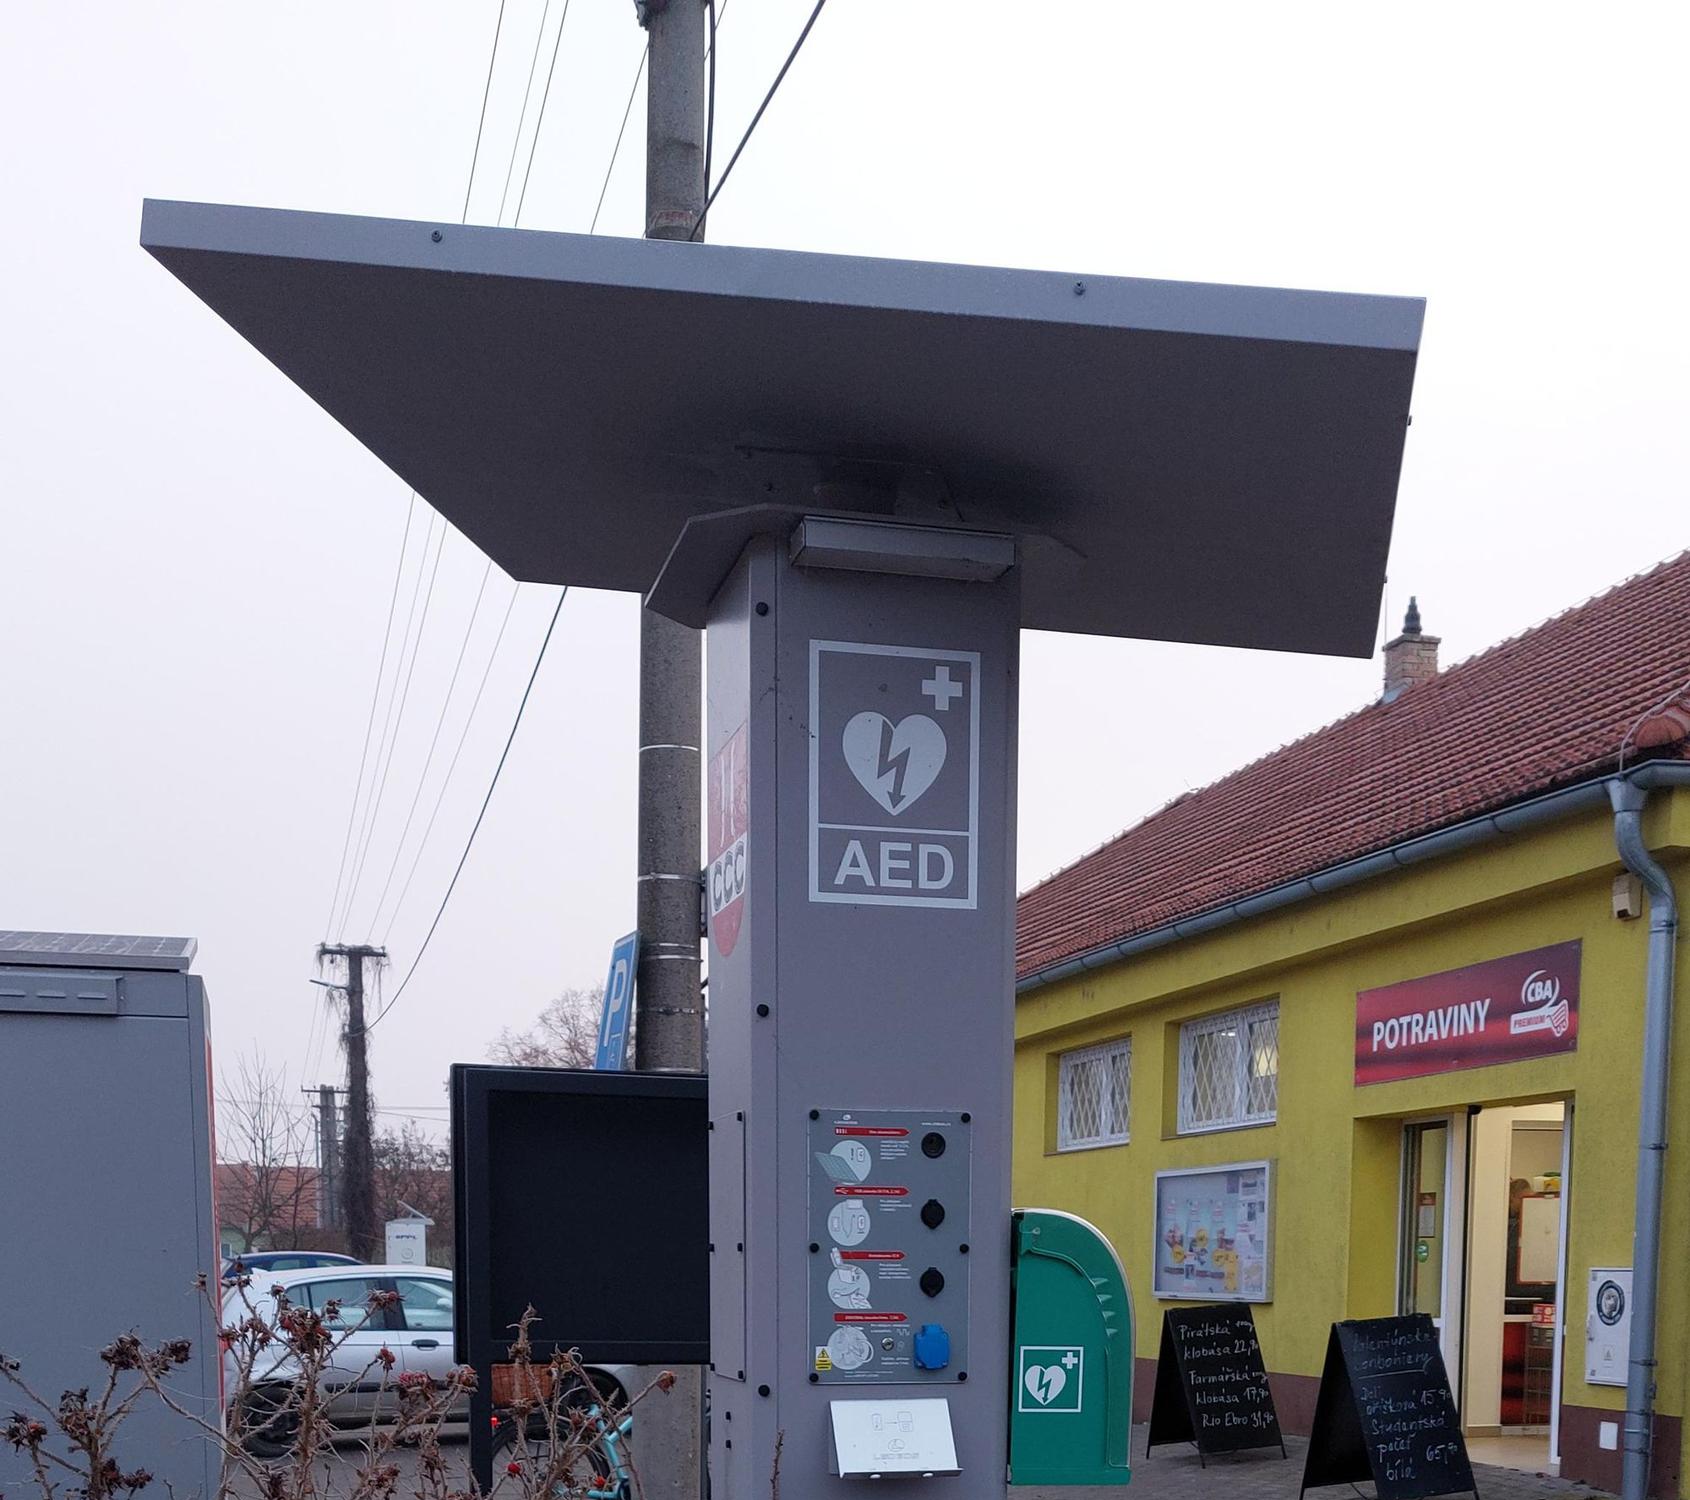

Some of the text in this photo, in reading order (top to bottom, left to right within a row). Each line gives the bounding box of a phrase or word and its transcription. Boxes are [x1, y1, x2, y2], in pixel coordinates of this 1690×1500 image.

[834, 840, 954, 890] AED
[604, 958, 627, 1047] P
[1526, 979, 1553, 1003] CBA
[1372, 998, 1491, 1052] POTRAVINY
[1201, 1413, 1221, 1428] Rio
[1225, 1411, 1249, 1426] Ebro
